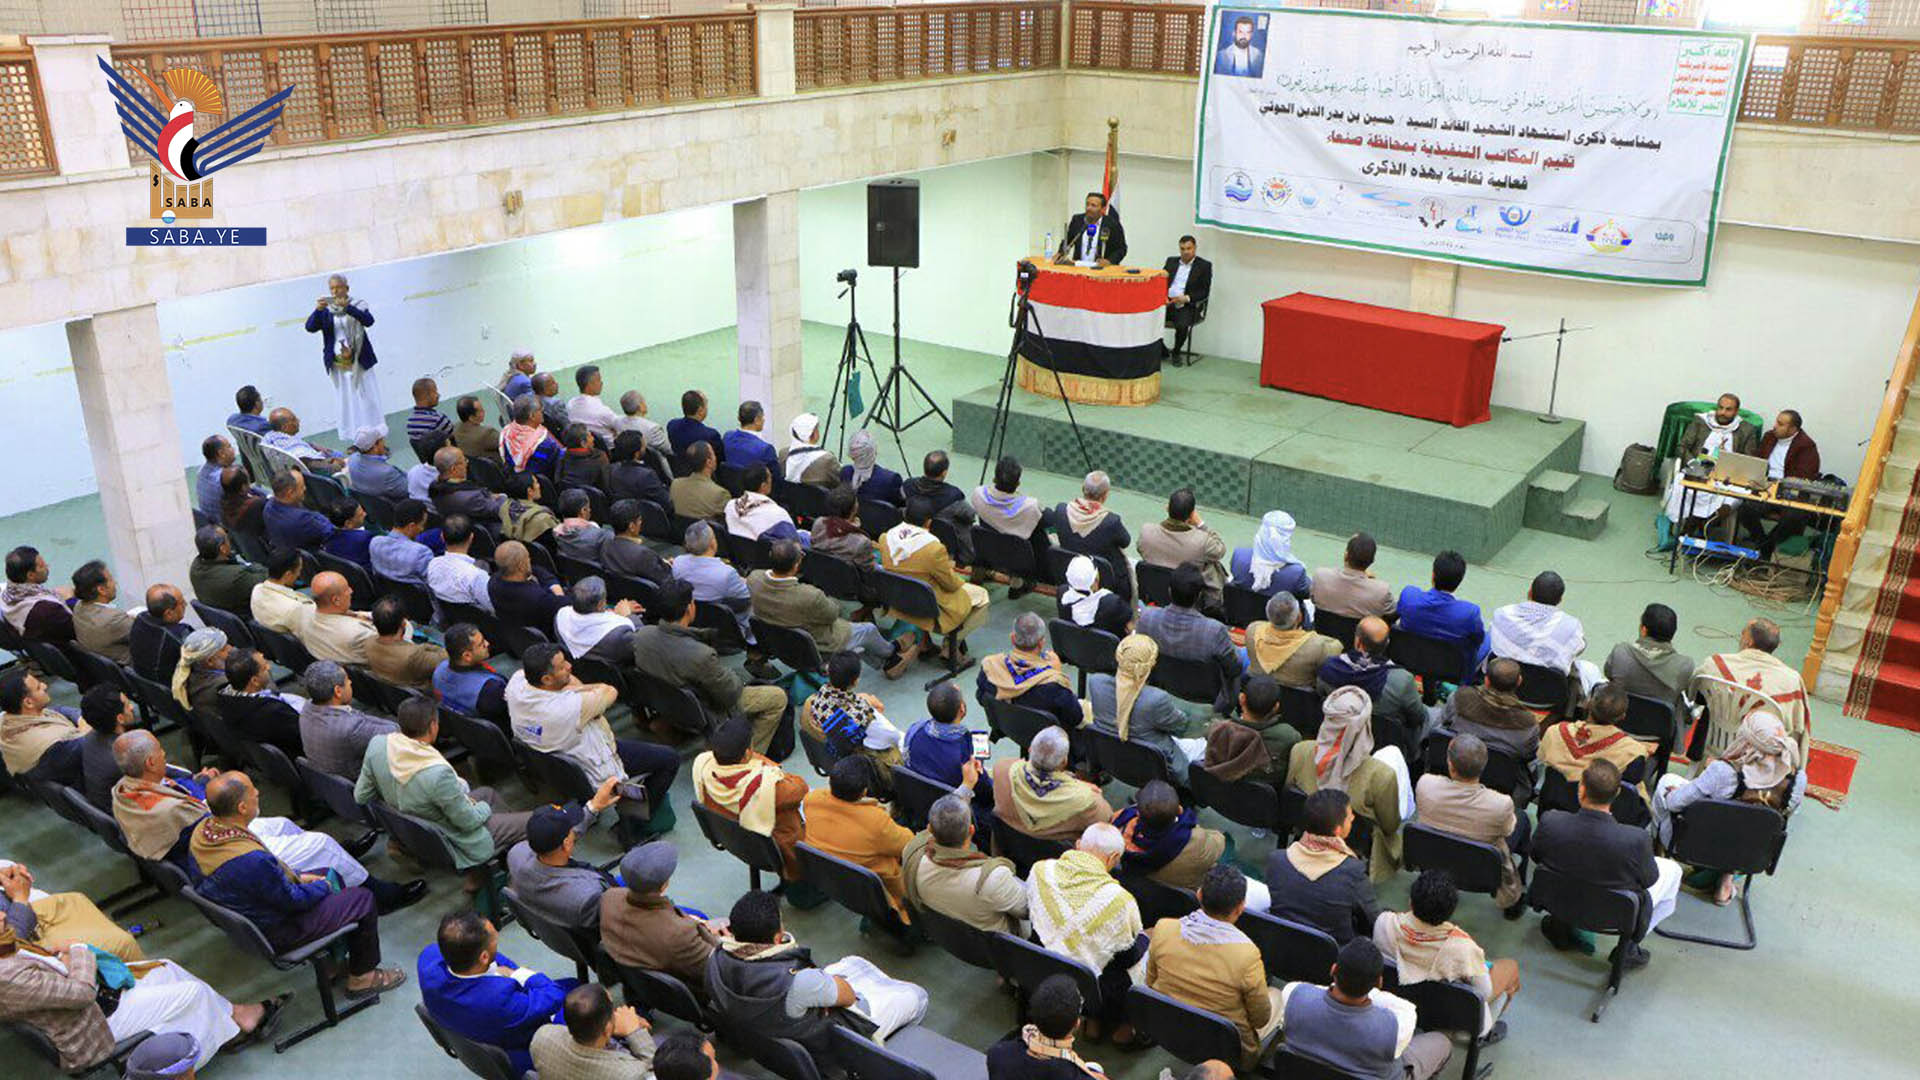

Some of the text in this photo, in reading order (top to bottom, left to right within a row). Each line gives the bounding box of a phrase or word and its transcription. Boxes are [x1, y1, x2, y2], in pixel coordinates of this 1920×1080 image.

[1259, 100, 1295, 117] الحوثي
[1296, 104, 1325, 119] الدين
[1326, 108, 1345, 121] بدر
[1346, 109, 1360, 124] بن
[1363, 113, 1395, 126] حسين
[1406, 115, 1438, 132] السيد
[1440, 118, 1470, 133] القائد
[1473, 121, 1515, 138] الشهيد
[1518, 124, 1571, 142] استشهاد
[1573, 130, 1606, 147] ذكرى
[1610, 132, 1662, 152] بمناسبة
[1327, 129, 1576, 172] تقيم المكاتب التنفيذية بمحافظة صنعاء
[1361, 158, 1407, 177] الذكرى
[1411, 163, 1444, 183] بهذه
[1487, 171, 1529, 191] فعالية
